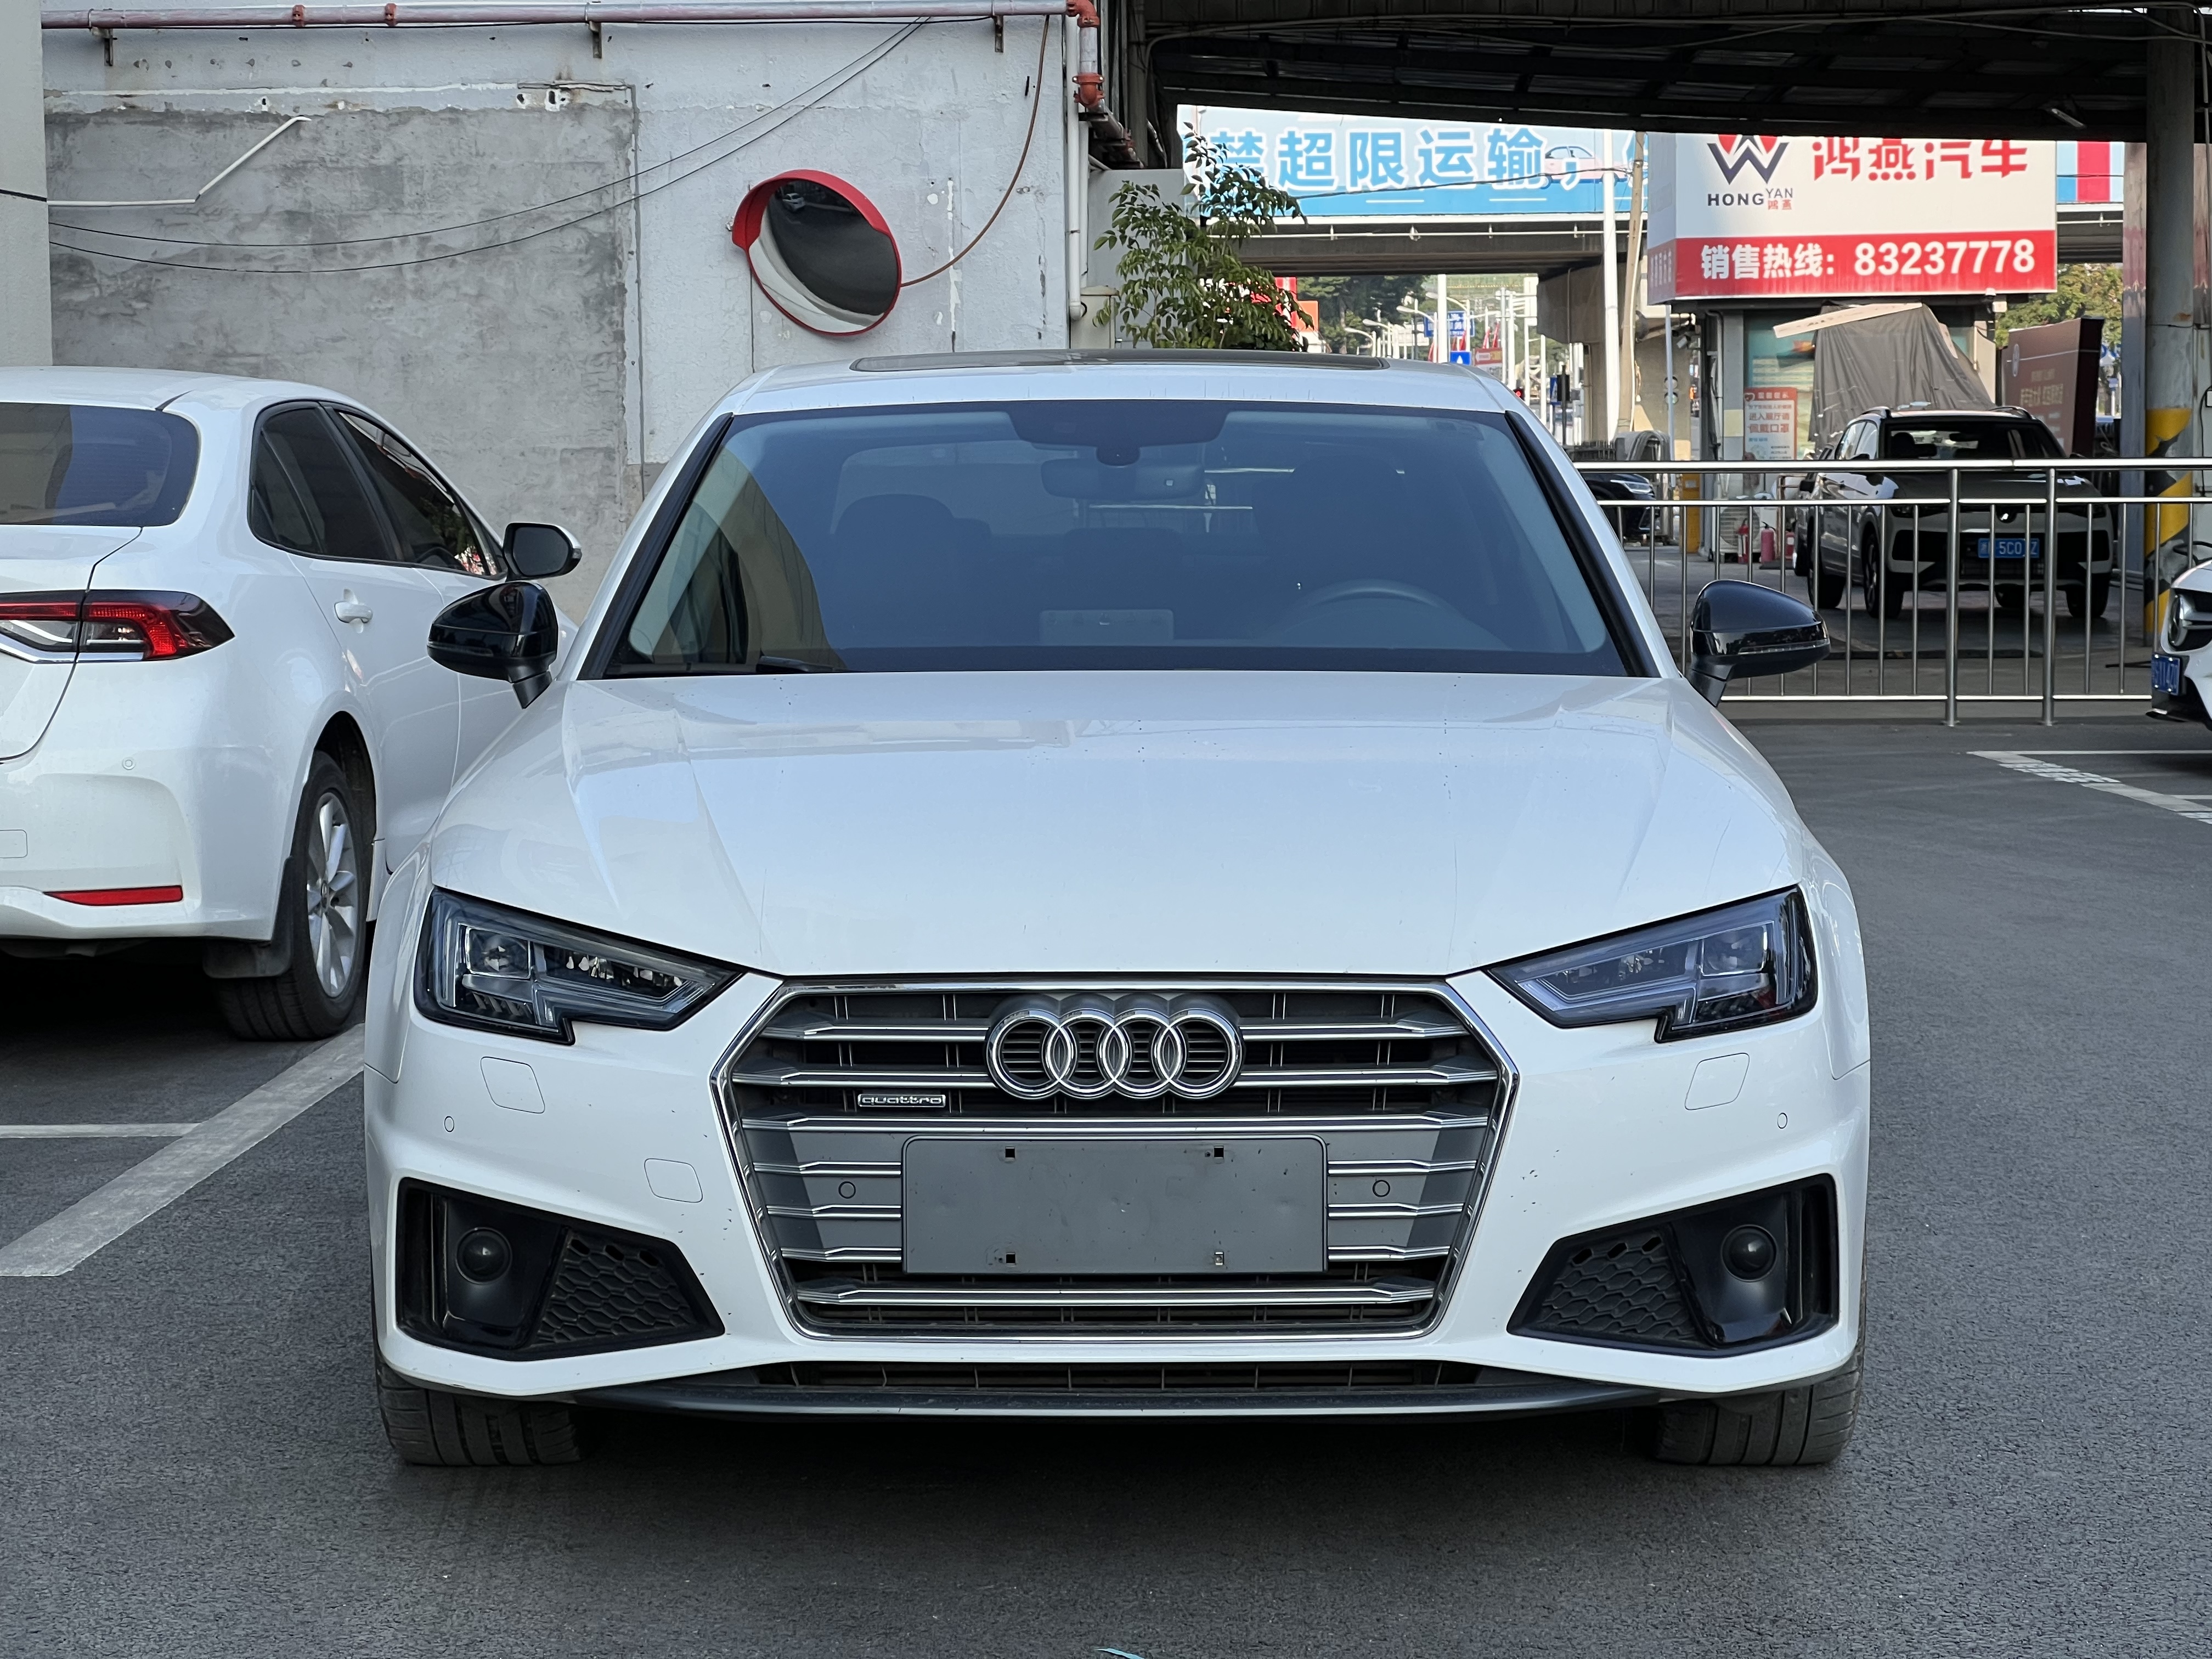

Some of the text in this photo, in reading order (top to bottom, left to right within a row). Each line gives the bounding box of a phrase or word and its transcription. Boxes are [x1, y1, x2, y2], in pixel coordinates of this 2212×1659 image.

[1812, 137, 2028, 182] 鸿燕汽车
[1707, 188, 1793, 206] HONG YAN
[1701, 243, 1833, 279] 销售热线：
[1855, 239, 2035, 276] 83237778
[1980, 541, 2038, 555] 5C0Z
[861, 1096, 943, 1105] quattro
